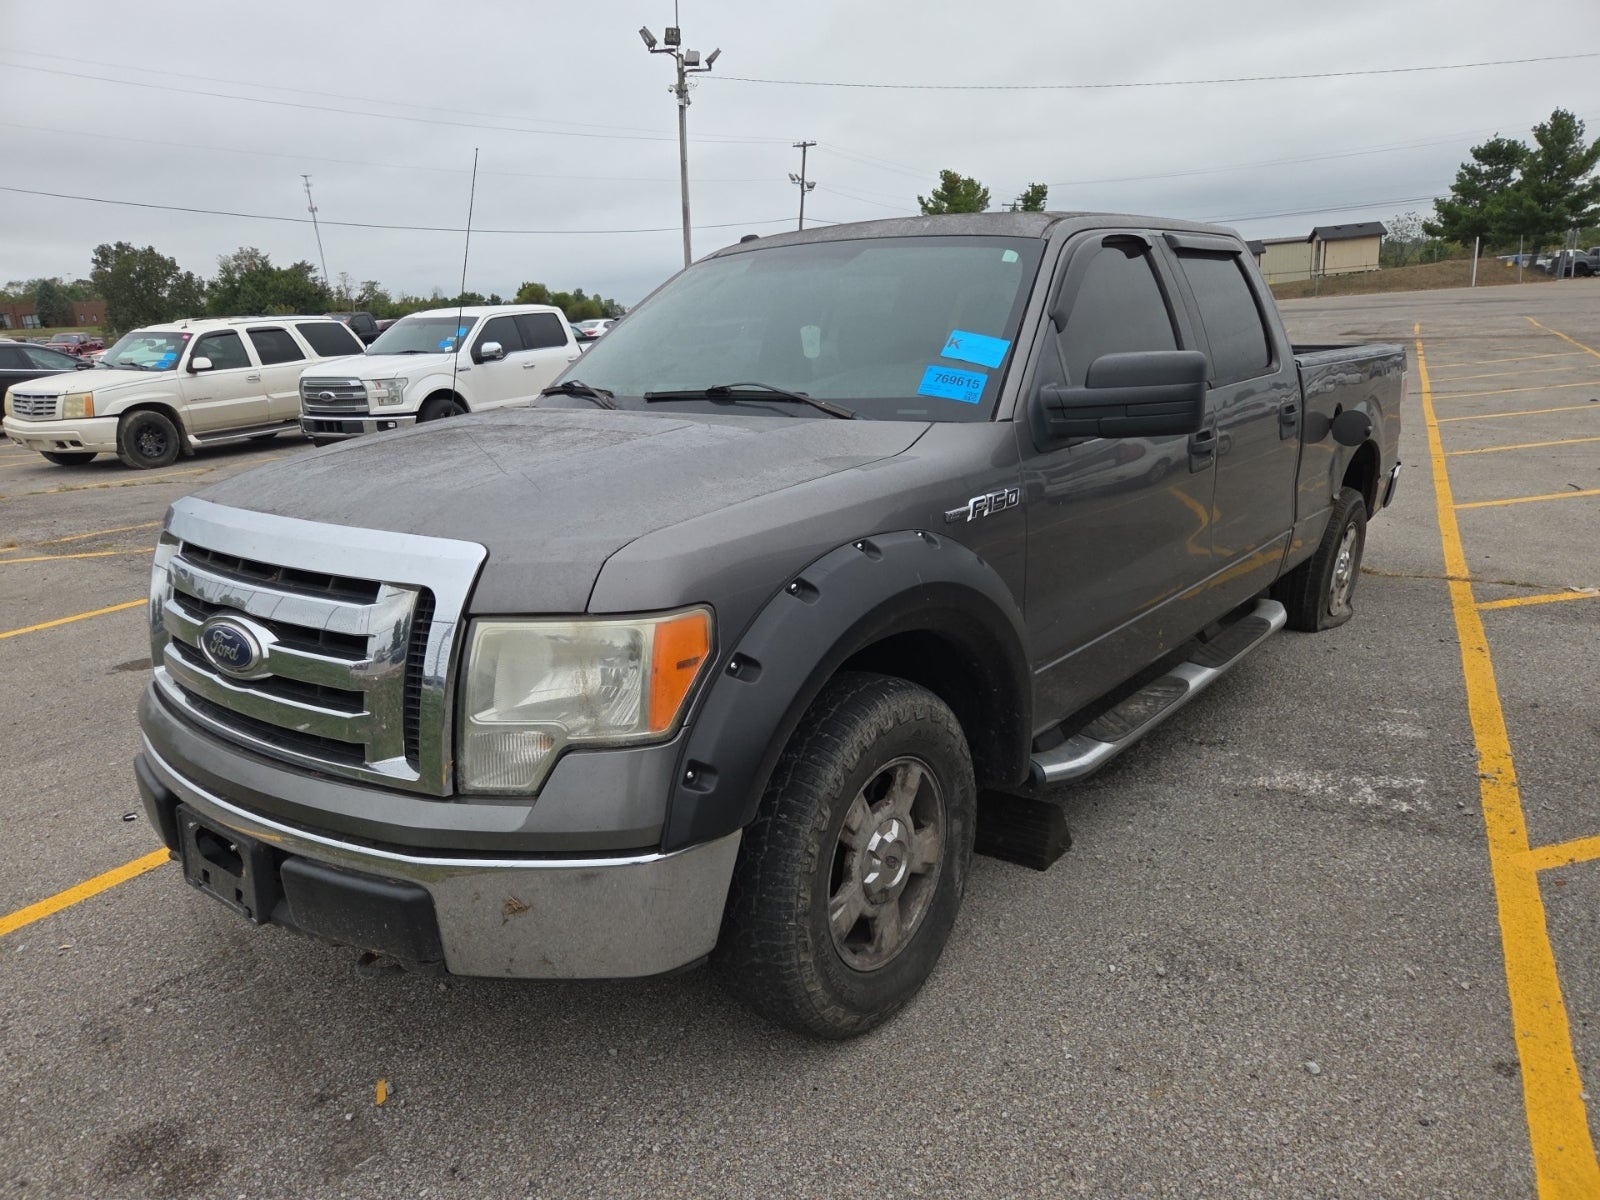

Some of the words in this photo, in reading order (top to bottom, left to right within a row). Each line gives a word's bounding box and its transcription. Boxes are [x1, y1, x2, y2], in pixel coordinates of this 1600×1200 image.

[947, 338, 962, 349] K
[934, 373, 981, 390] 769615
[209, 630, 240, 661] Ford
